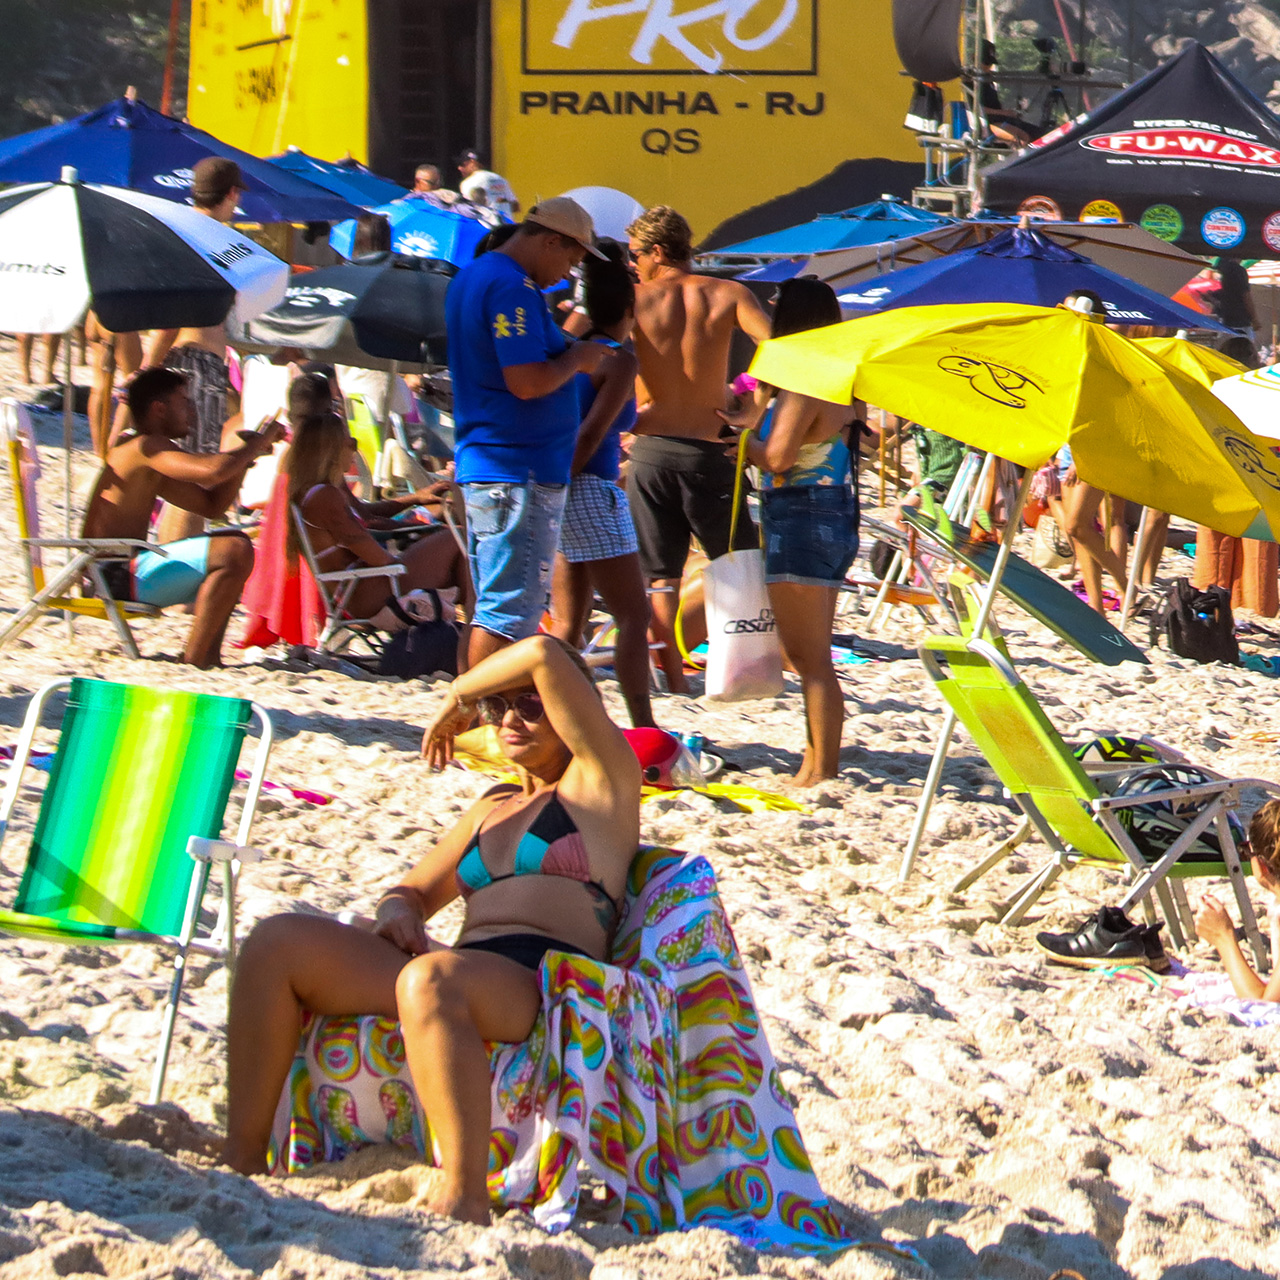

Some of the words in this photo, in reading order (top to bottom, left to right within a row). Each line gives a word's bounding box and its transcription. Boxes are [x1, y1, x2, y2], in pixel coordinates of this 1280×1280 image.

[519, 91, 719, 114] PRAINHA
[765, 91, 825, 116] RJ
[640, 128, 700, 155] QS
[1225, 127, 1258, 140] WAX
[515, 306, 527, 336] vivo
[1106, 310, 1153, 320] ona
